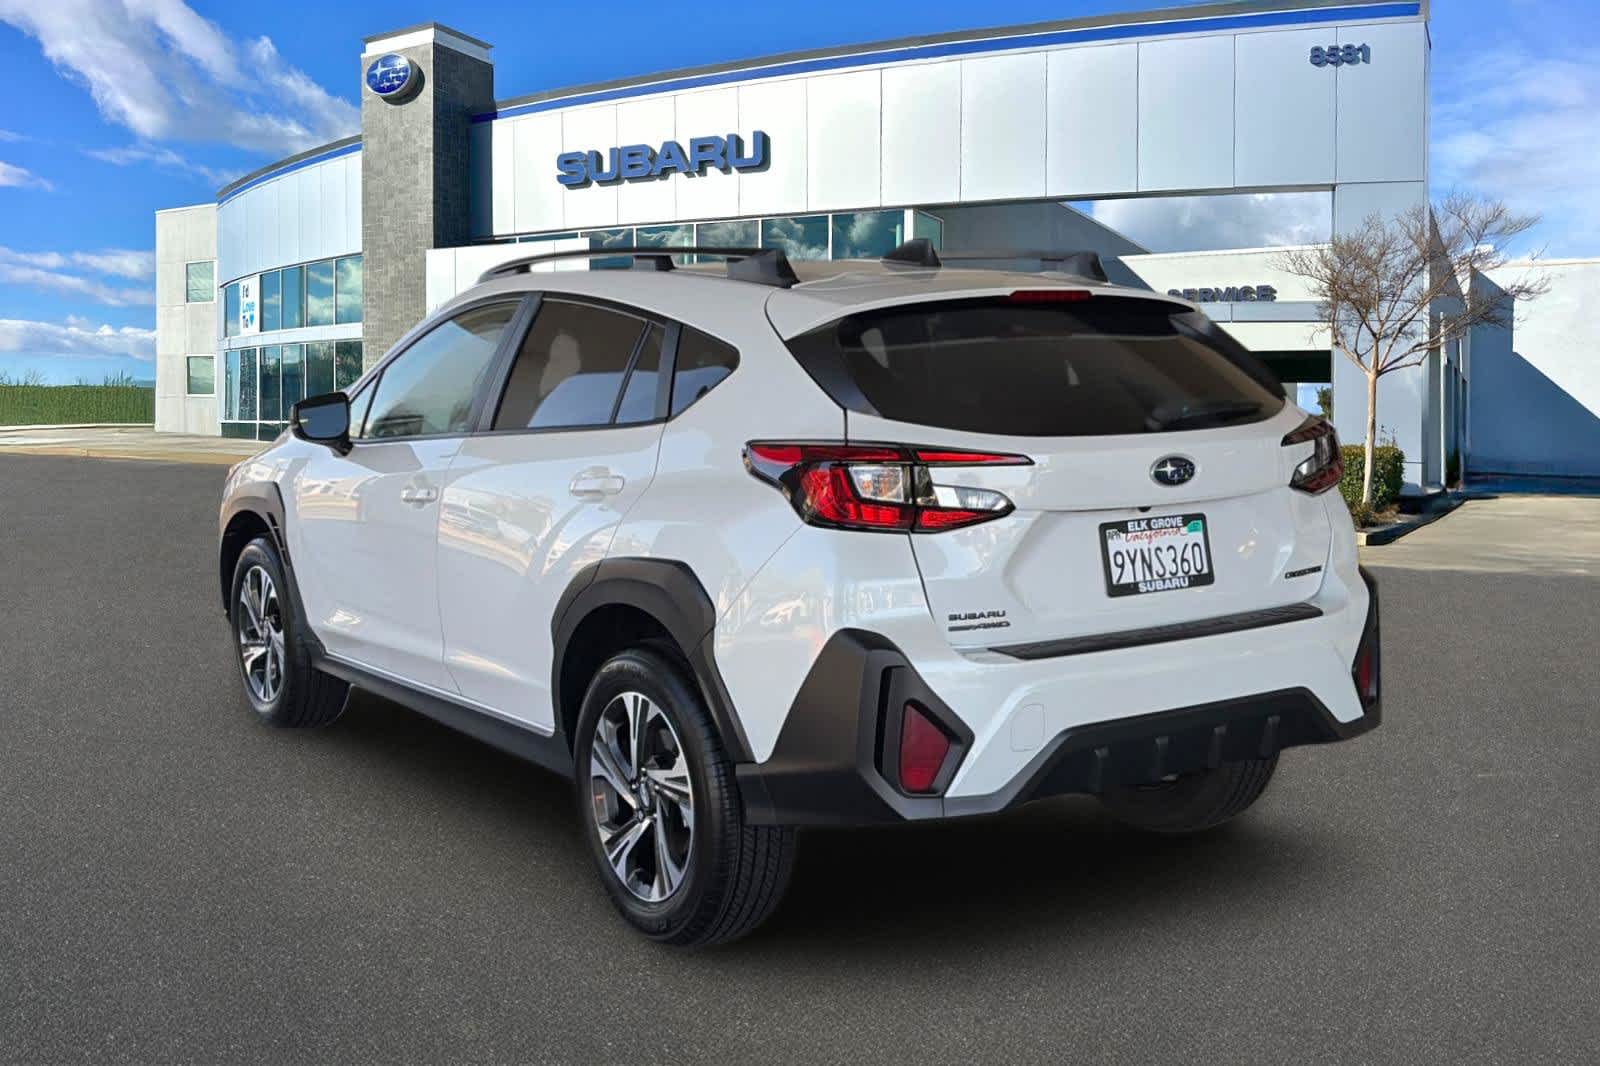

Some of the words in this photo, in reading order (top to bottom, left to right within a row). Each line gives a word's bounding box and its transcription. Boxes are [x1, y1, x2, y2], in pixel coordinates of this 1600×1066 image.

[556, 130, 771, 190] SUBARU
[1127, 521, 1148, 532] ELK
[1150, 516, 1183, 529] GROVE
[1113, 541, 1205, 584] 9YNS360
[1138, 576, 1189, 593] SUBARU
[948, 610, 1006, 621] SUBARU
